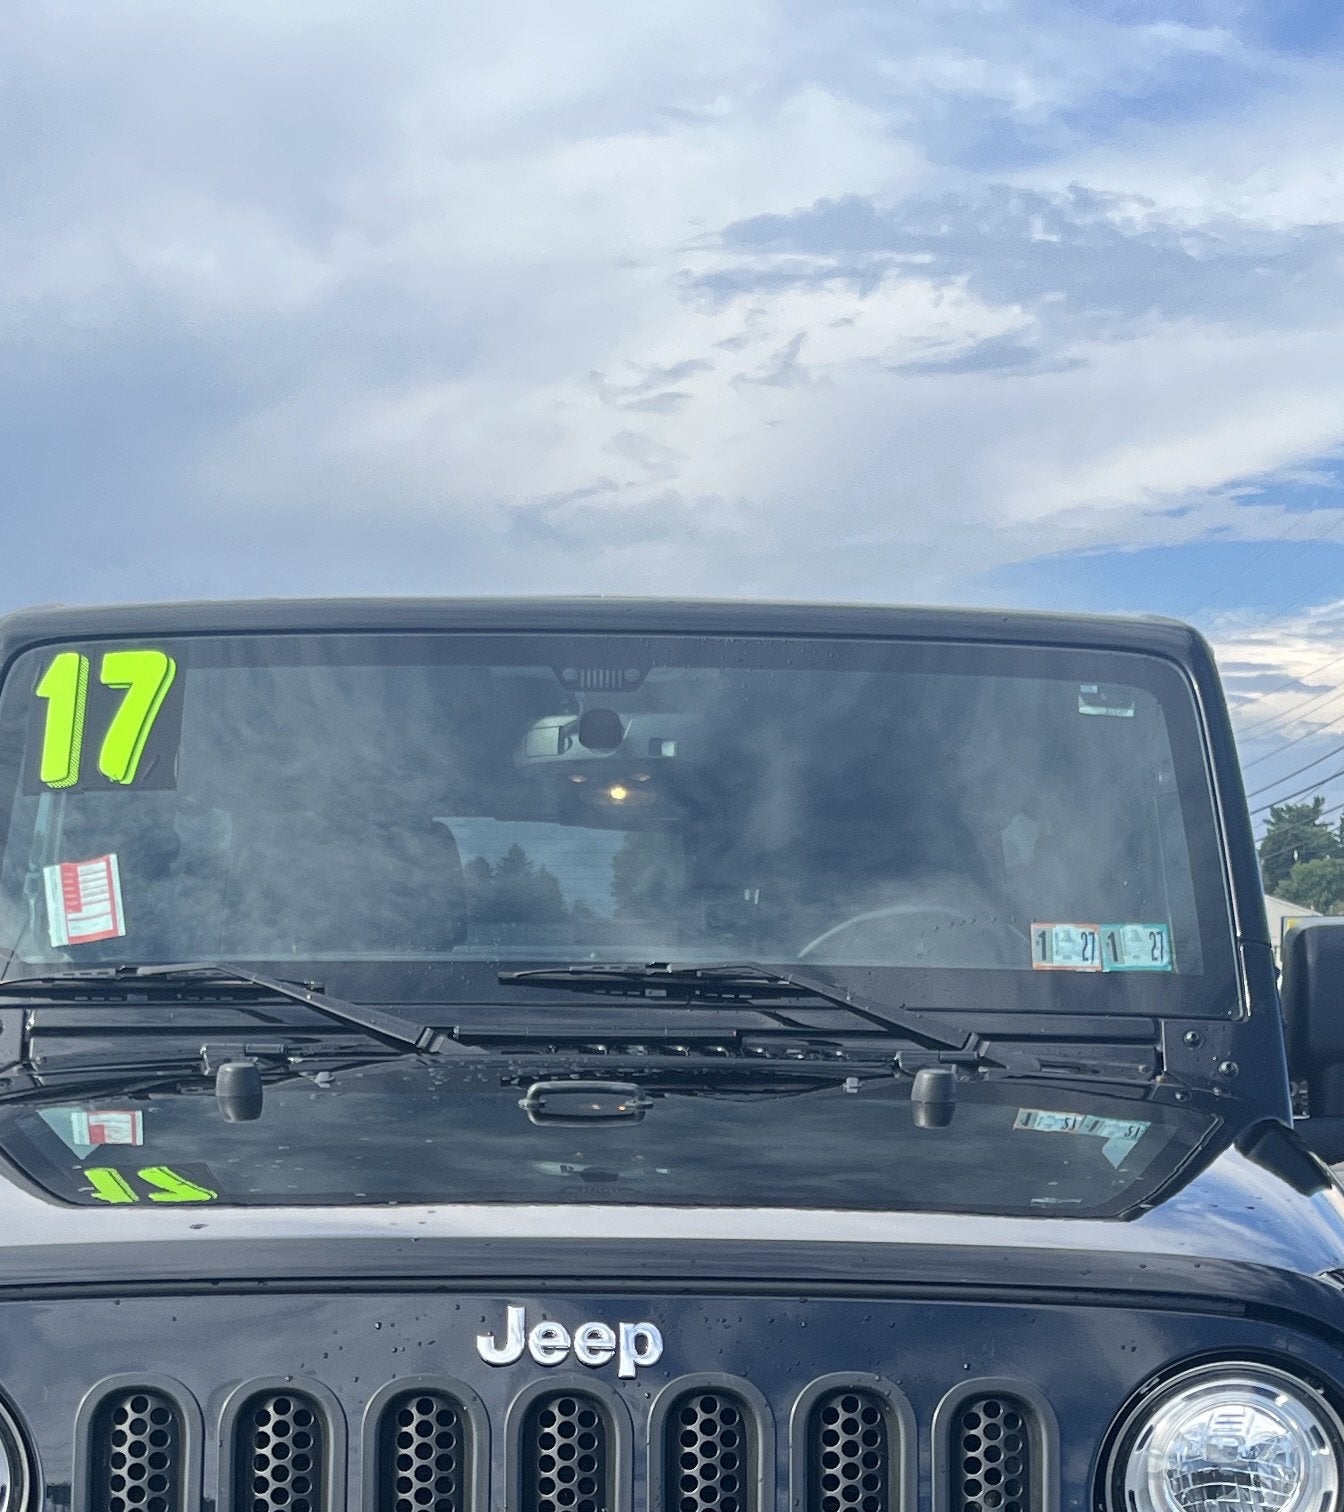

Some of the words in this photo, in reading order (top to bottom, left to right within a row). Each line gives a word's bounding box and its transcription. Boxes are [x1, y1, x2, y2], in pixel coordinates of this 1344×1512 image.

[36, 651, 176, 788] 17
[1038, 930, 1047, 961] 1
[1080, 931, 1096, 963] 27
[1107, 932, 1118, 962] 1
[1148, 931, 1164, 962] 27
[476, 1304, 664, 1379] Jeep
